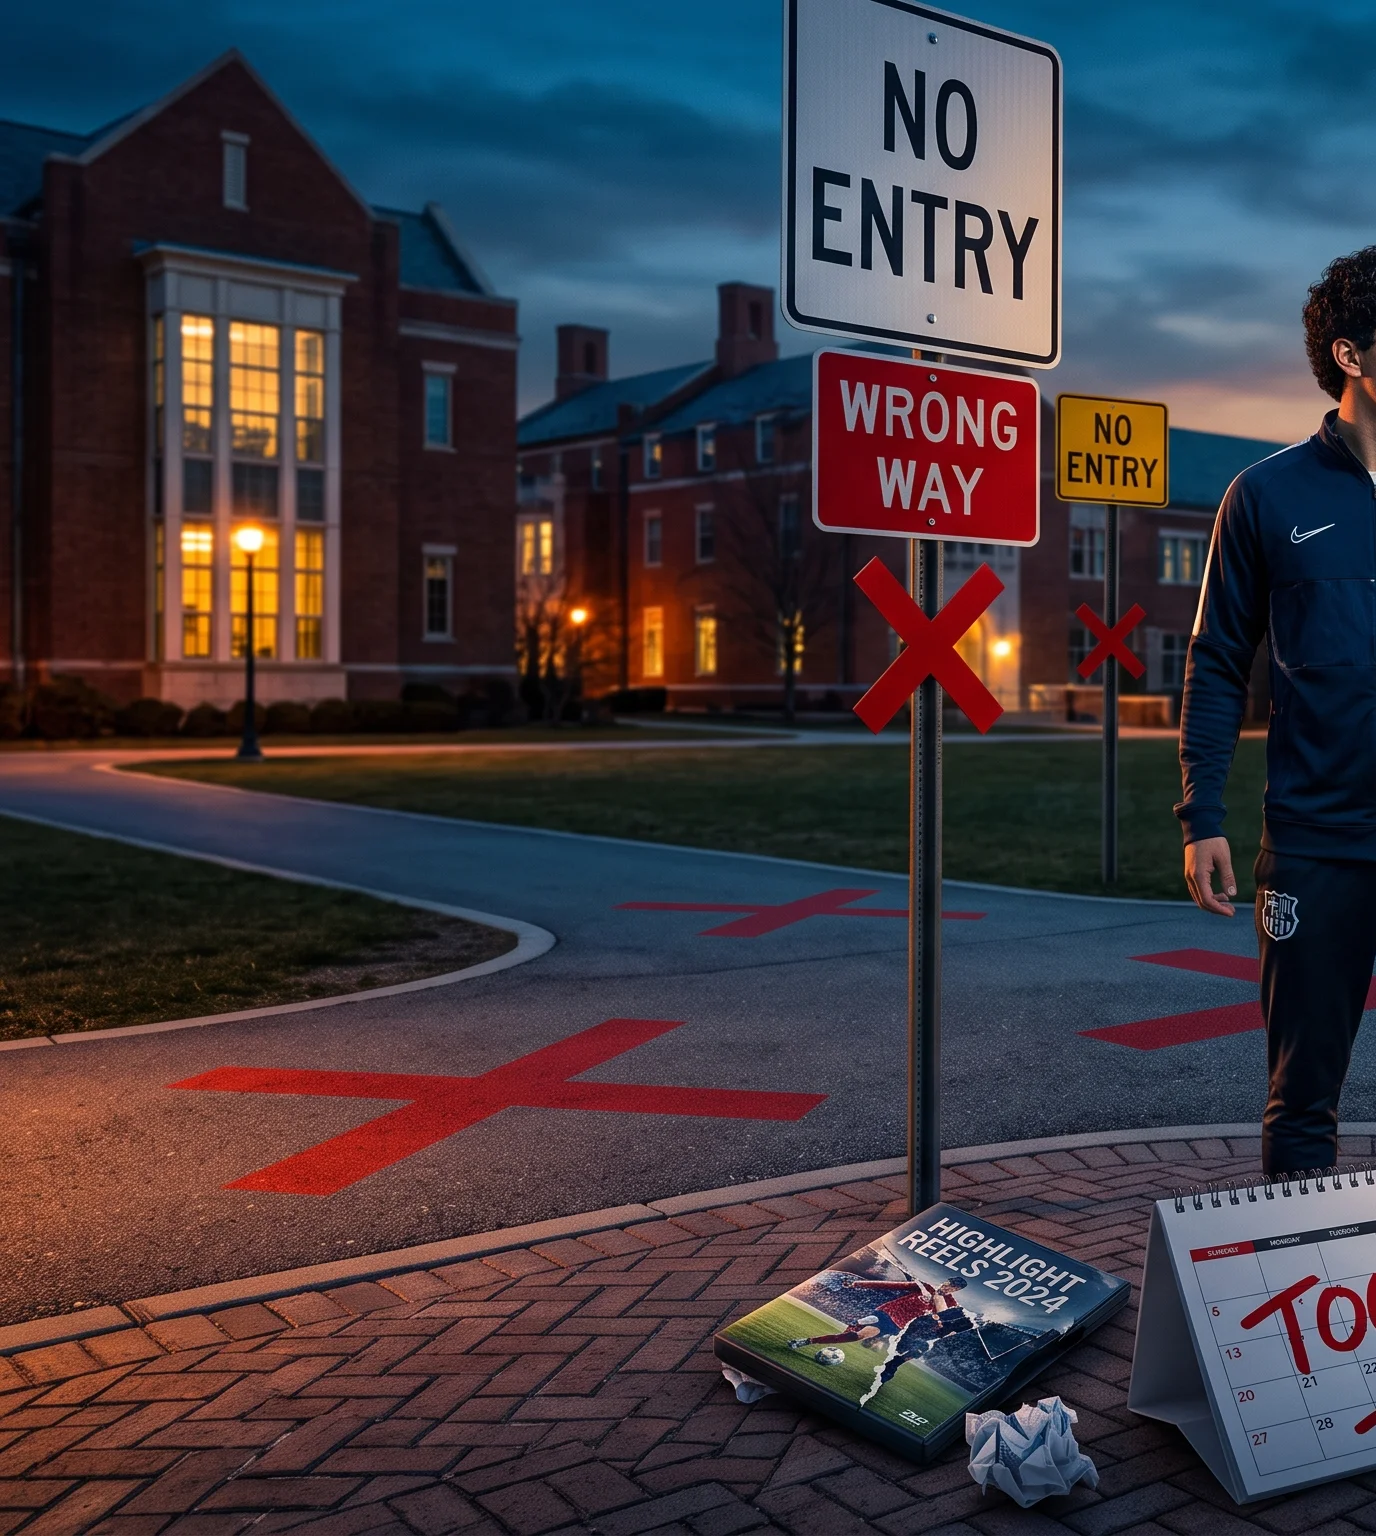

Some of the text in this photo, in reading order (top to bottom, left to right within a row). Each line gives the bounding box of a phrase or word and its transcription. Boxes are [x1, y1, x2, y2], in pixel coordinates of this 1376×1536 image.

[883, 60, 978, 171] NO
[811, 166, 1040, 301] ENTRY
[839, 379, 1018, 452] WRONG
[1094, 412, 1133, 447] NO
[876, 456, 985, 516] WAY
[1067, 452, 1159, 490] ENTRY
[897, 1230, 1070, 1315] REELS 2024
[927, 1217, 1087, 1293] HIGHLIGHT
[1212, 1306, 1220, 1317] 5
[1225, 1347, 1242, 1360] 13
[1237, 1389, 1255, 1403] 20
[1302, 1375, 1318, 1389] 21
[1251, 1431, 1268, 1446] 27
[1316, 1417, 1334, 1431] 28
